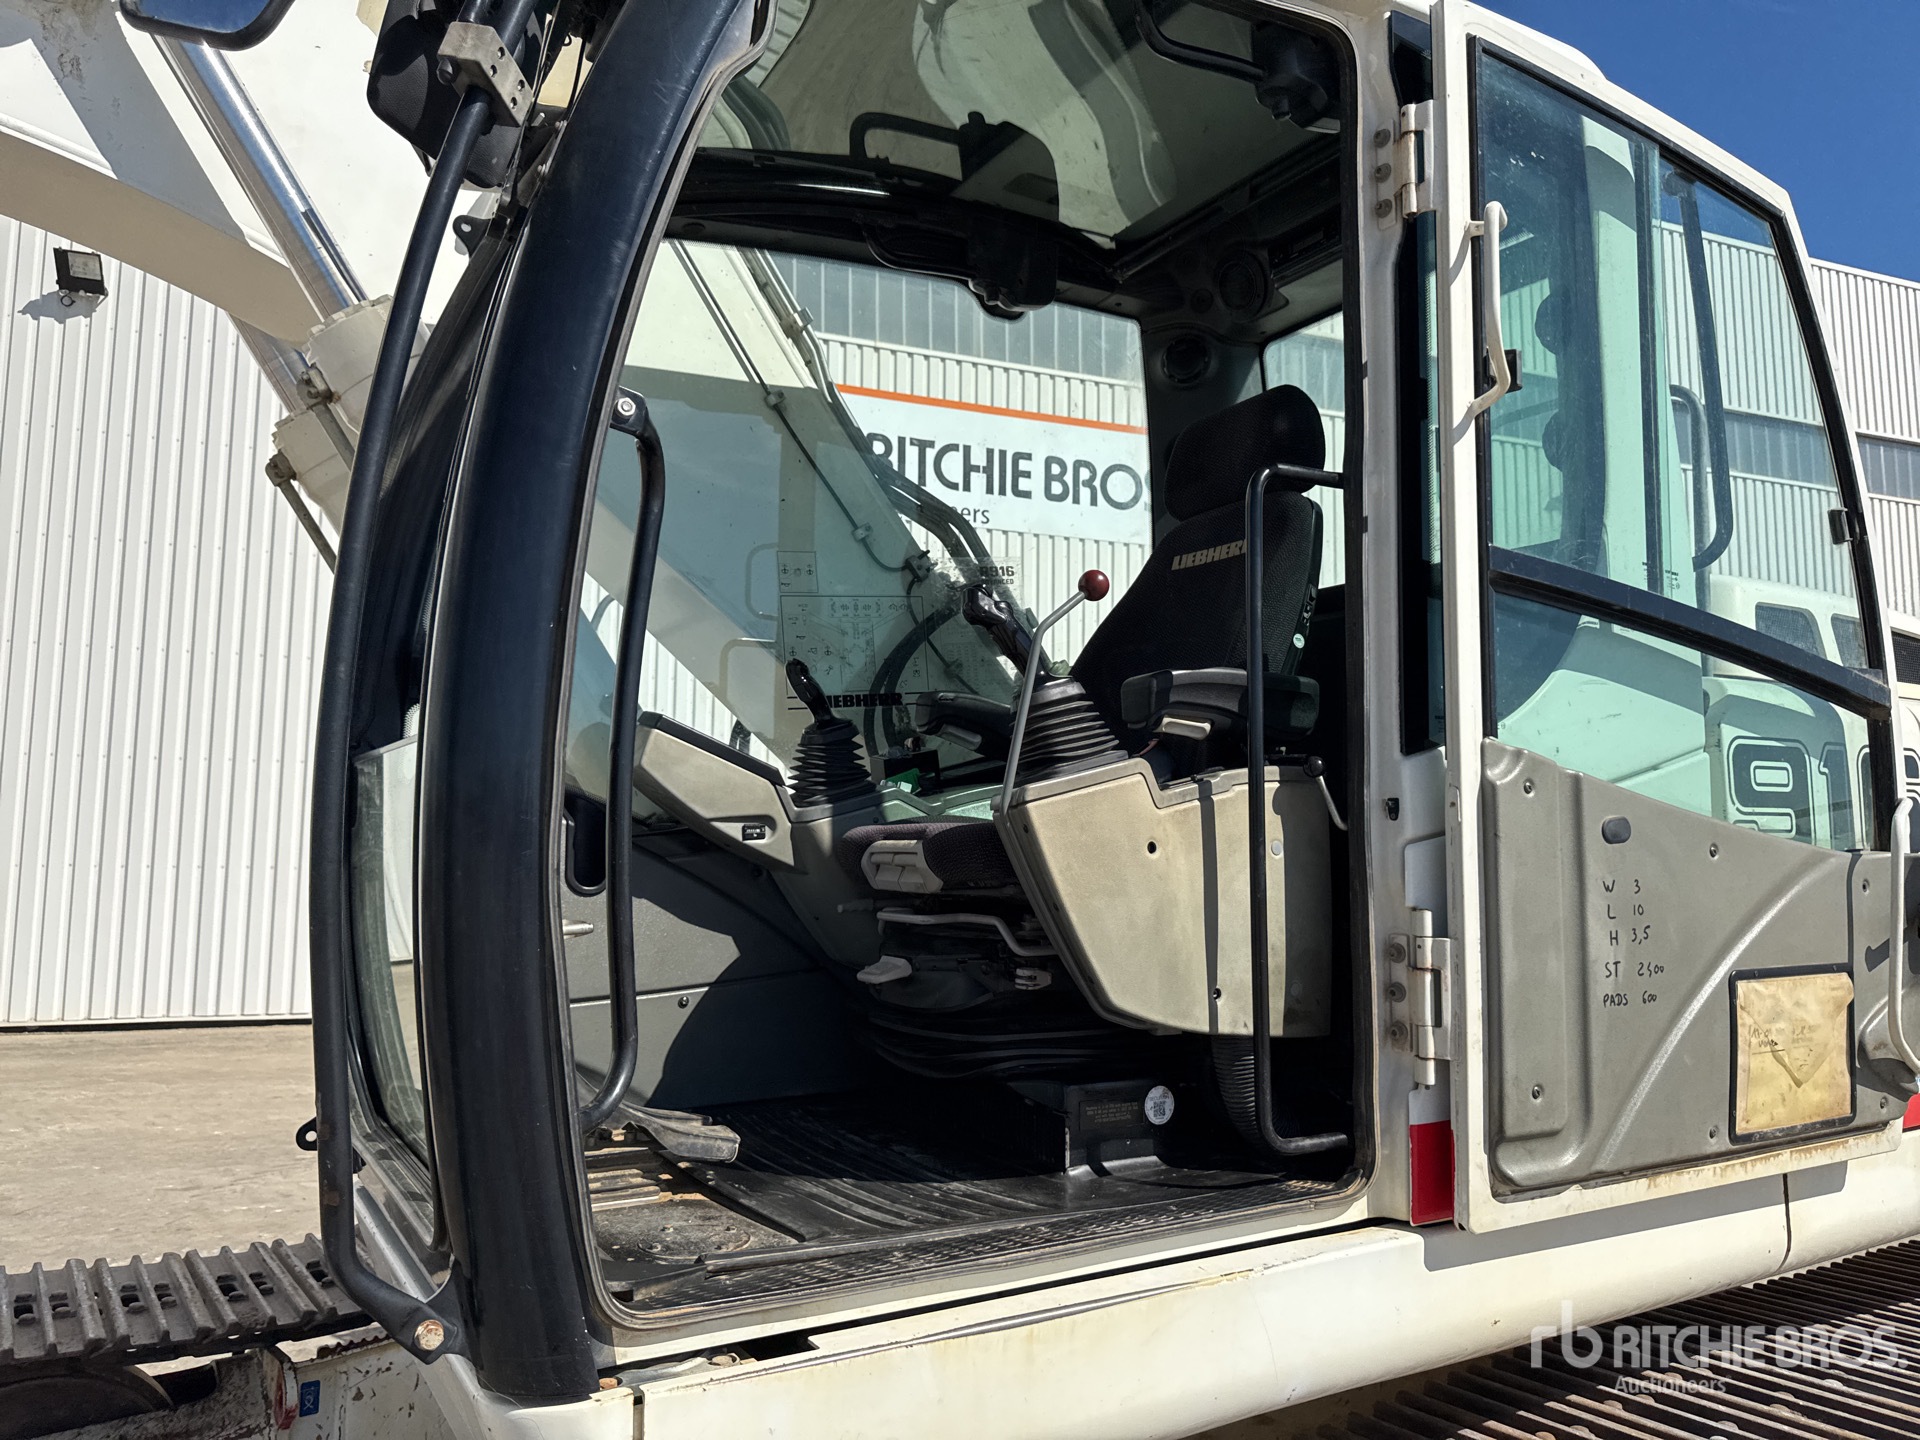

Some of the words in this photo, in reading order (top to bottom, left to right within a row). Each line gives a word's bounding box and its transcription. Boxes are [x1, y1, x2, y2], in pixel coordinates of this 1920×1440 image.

[1044, 456, 1151, 511] BRO
[825, 693, 903, 708] IEBHERR
[1602, 879, 1616, 893] W
[1634, 879, 1641, 895] 3
[1607, 903, 1617, 920] L
[1633, 904, 1645, 916] 10
[1609, 929, 1619, 946] H
[1631, 925, 1651, 945] 3,5
[1604, 961, 1621, 979] ST
[1602, 993, 1629, 1008] PADS
[1642, 990, 1658, 1005] 600
